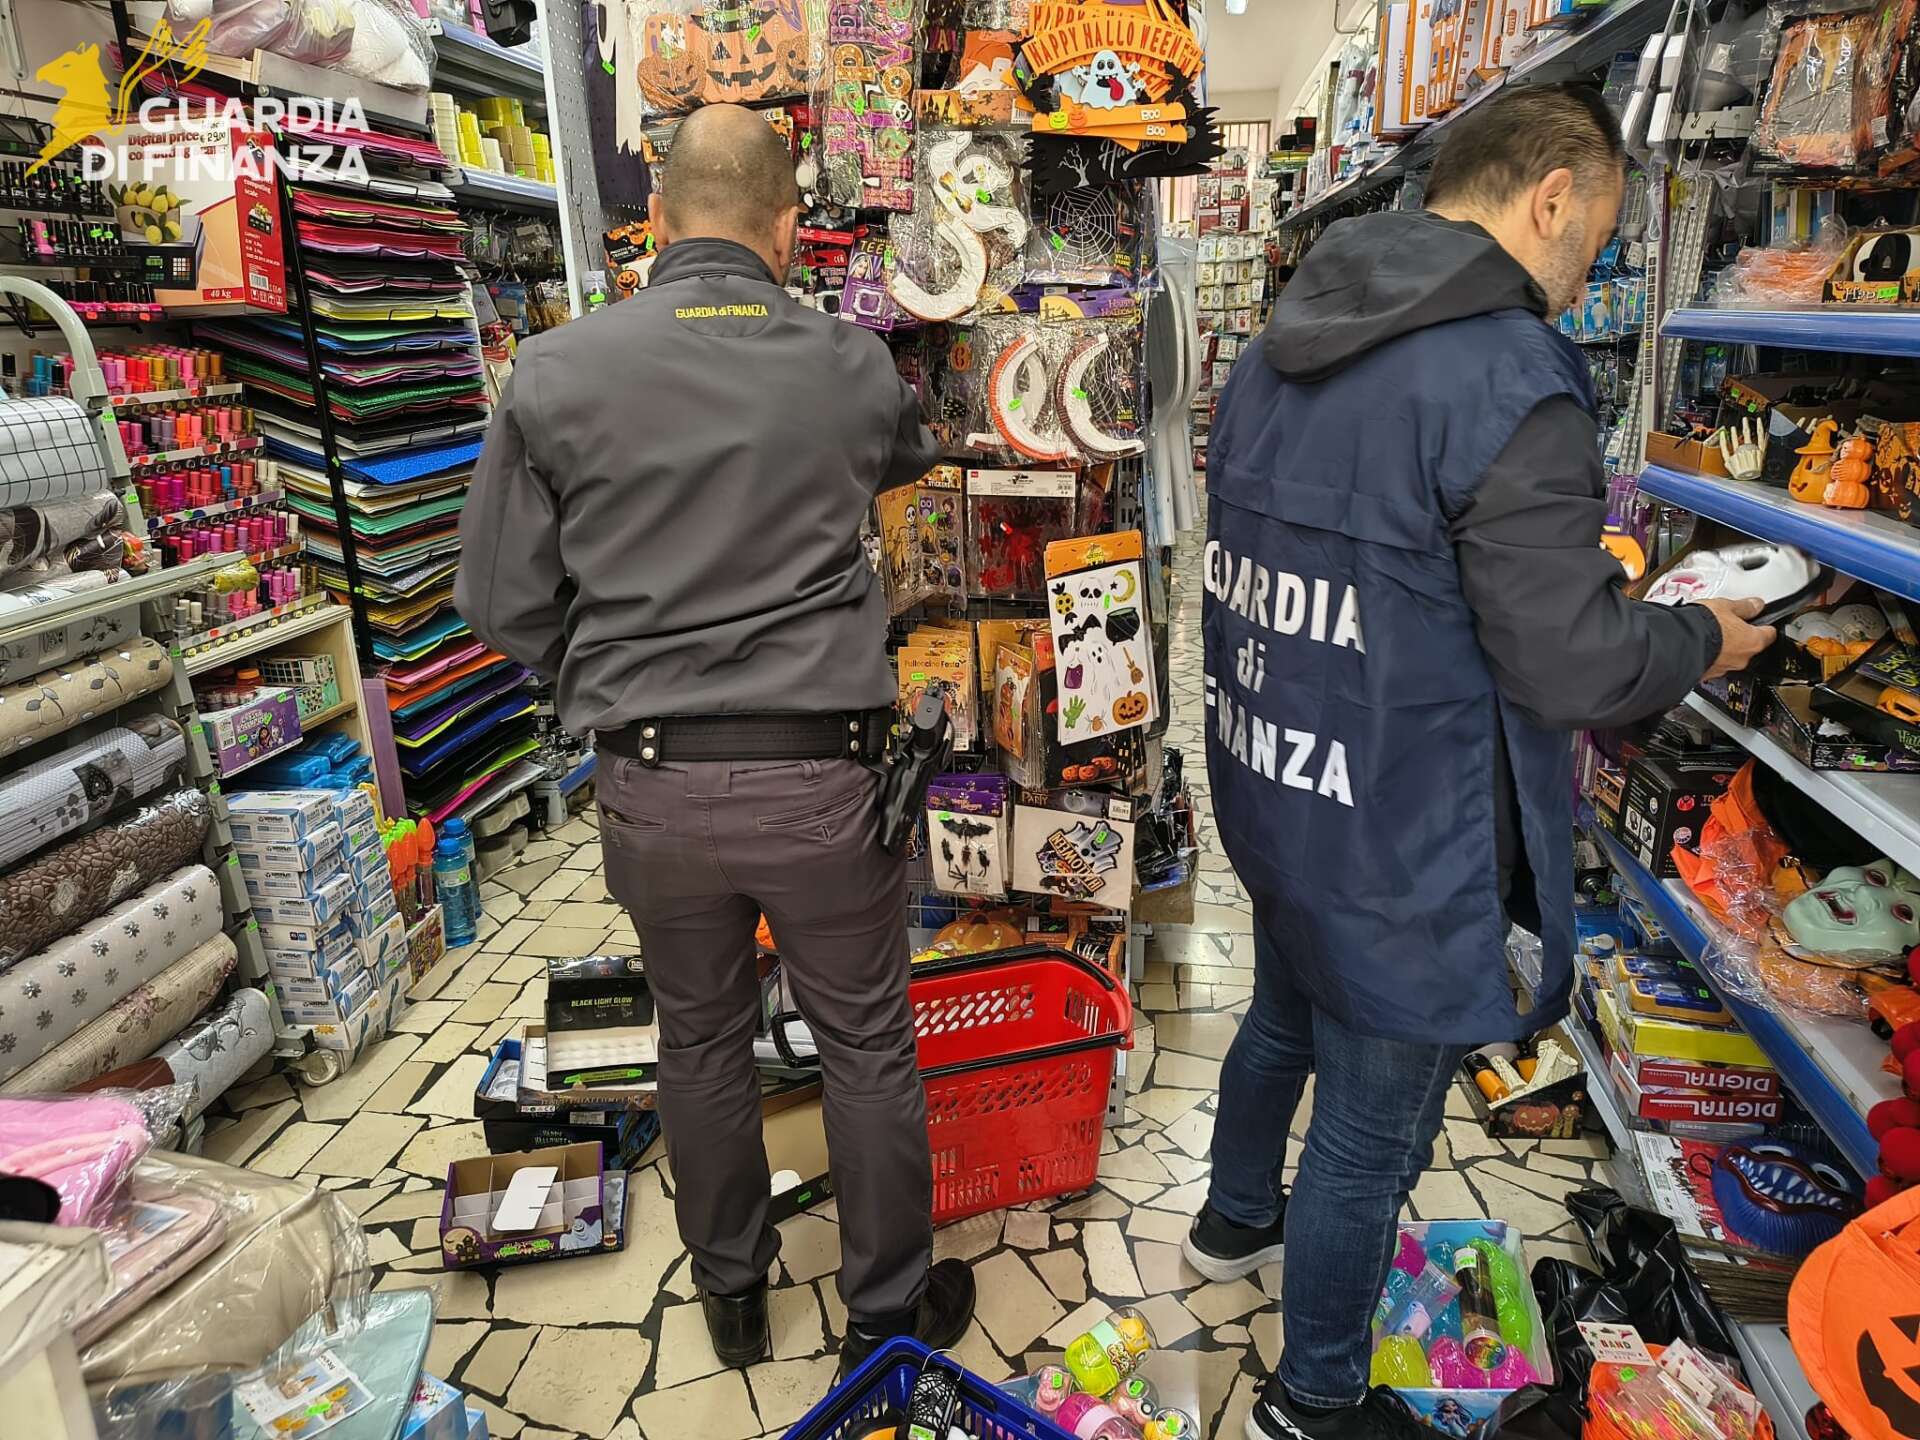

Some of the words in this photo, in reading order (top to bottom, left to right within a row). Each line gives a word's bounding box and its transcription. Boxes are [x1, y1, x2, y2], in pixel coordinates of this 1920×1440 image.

[1027, 25, 1079, 69] HAPPY
[128, 132, 168, 147] Digital
[170, 130, 201, 145] price
[223, 289, 232, 299] kg
[675, 306, 718, 319] GUARDIA
[719, 308, 727, 316] di
[727, 304, 769, 316] FINANZA
[1204, 540, 1367, 655] GUARDIA
[1236, 638, 1266, 694] di
[1204, 673, 1354, 808] FNANZA
[1051, 832, 1102, 892] HALLOWEEN
[571, 999, 593, 1007] BLACK
[594, 998, 613, 1006] LIGHT
[614, 996, 633, 1004] GLOW
[1684, 1071, 1770, 1092] DIGITAL
[1693, 1100, 1777, 1118] DIGITAL
